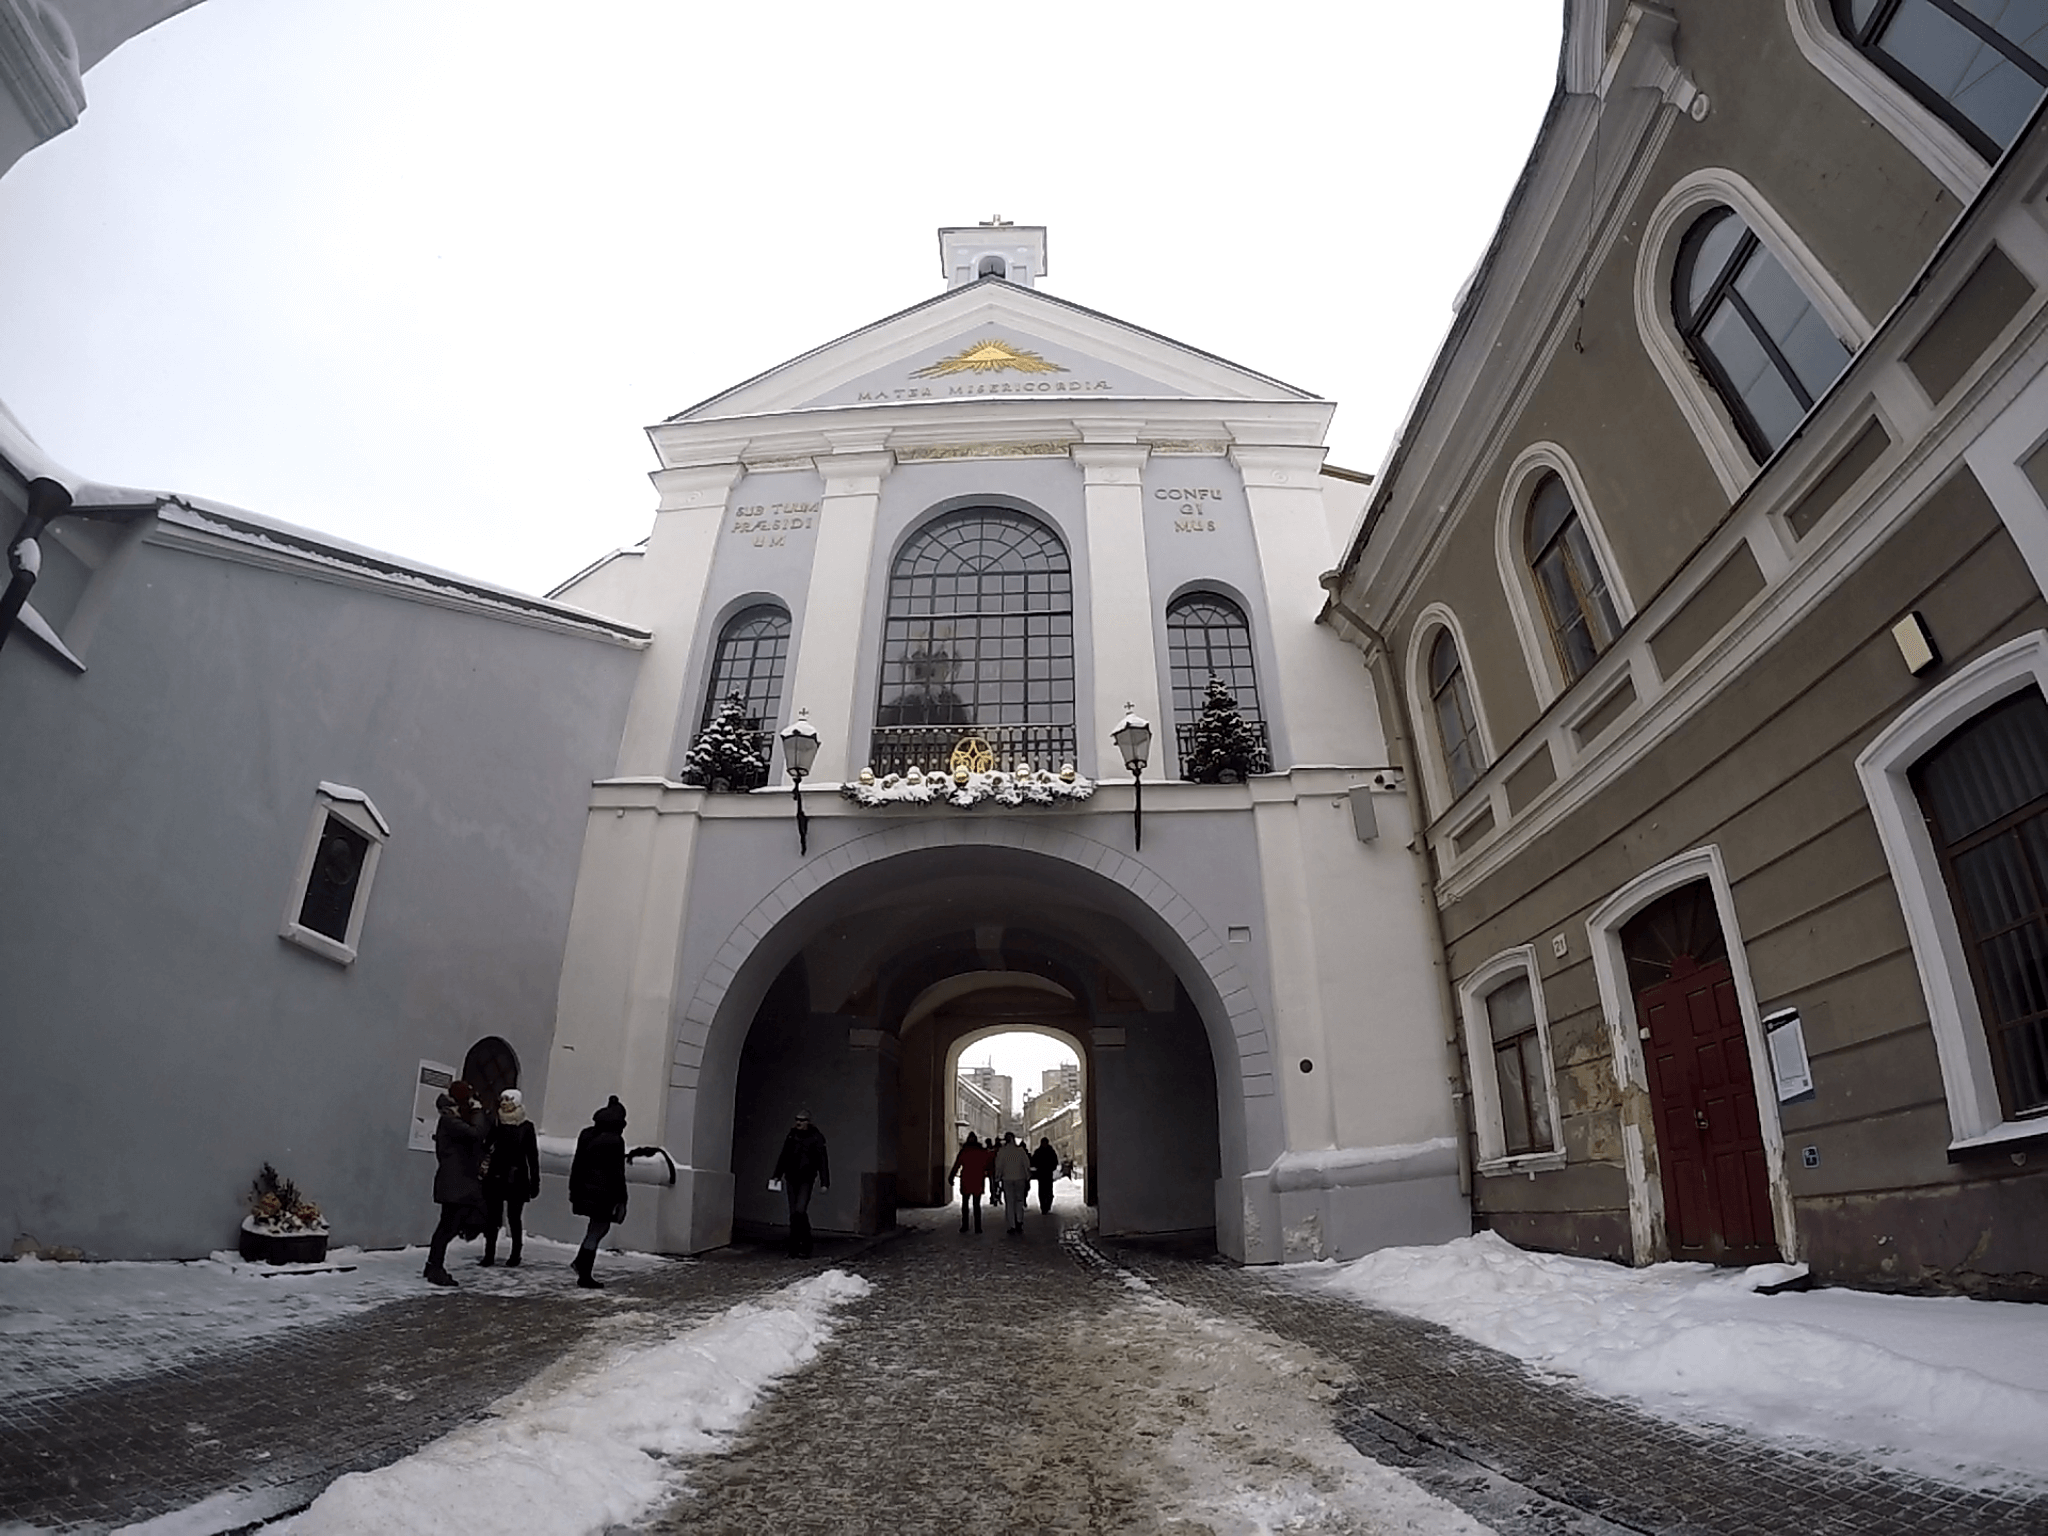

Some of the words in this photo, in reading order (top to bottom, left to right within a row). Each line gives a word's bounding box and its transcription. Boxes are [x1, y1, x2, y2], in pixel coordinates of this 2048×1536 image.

[858, 387, 932, 400] MATER
[1154, 488, 1222, 500] CONFU
[736, 505, 765, 517] SUB
[771, 502, 820, 515] TUUM
[1180, 503, 1203, 515] GI
[1174, 520, 1216, 532] MUS
[1554, 939, 1565, 953] 21
